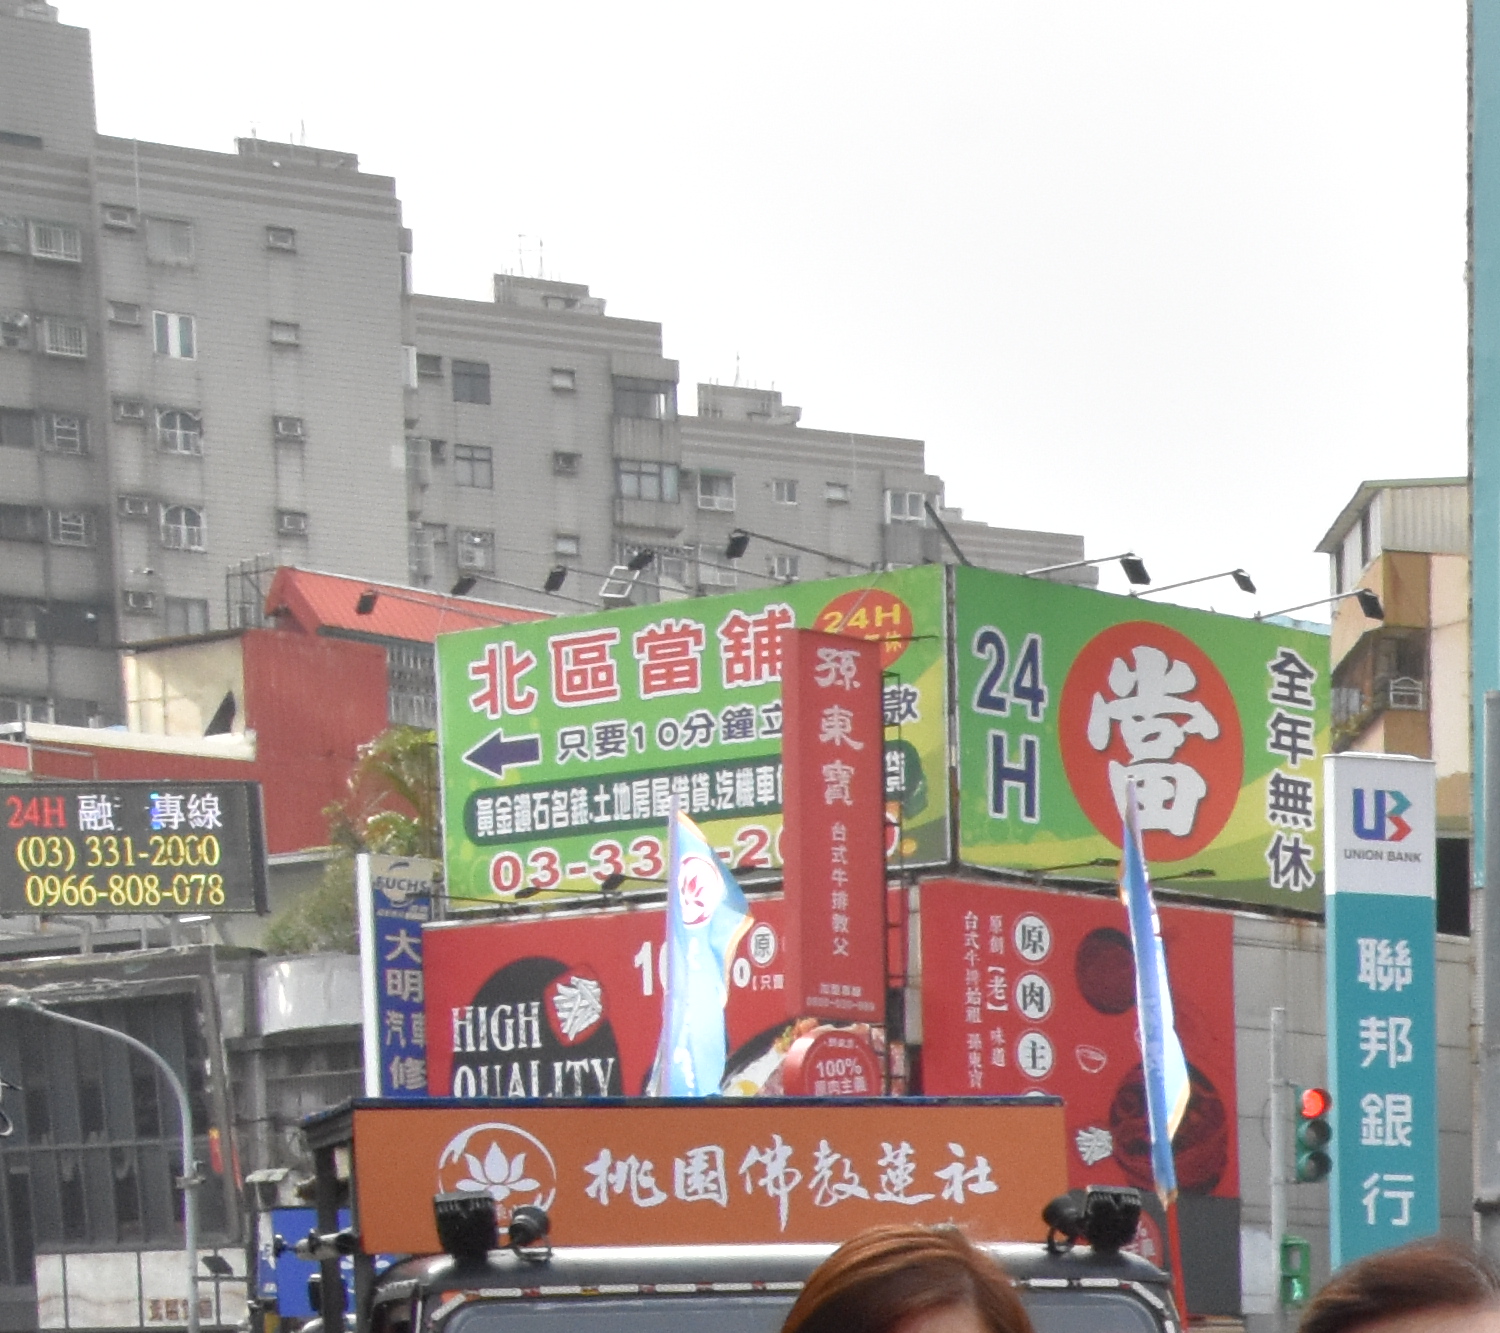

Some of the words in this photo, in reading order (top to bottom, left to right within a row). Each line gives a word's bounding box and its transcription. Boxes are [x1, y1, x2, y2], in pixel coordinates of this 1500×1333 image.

[972, 626, 1048, 722] 24
[1087, 645, 1220, 837] 當
[1267, 647, 1316, 893] 全年無休
[987, 730, 1041, 824] H
[7, 795, 68, 829] 24H
[17, 835, 76, 871] (03)
[85, 834, 221, 867] 331-2000
[1344, 848, 1384, 862] UNION
[1387, 850, 1422, 863] BANK
[25, 874, 226, 907] 0966-808-078
[384, 928, 422, 1004] 大明
[452, 1001, 542, 1053] HIGH
[452, 1057, 616, 1098] QUALITY
[816, 1058, 862, 1079] 100%
[1357, 937, 1415, 1228] 聯邦銀行
[584, 1132, 998, 1232] 桃園佛教蓮社
